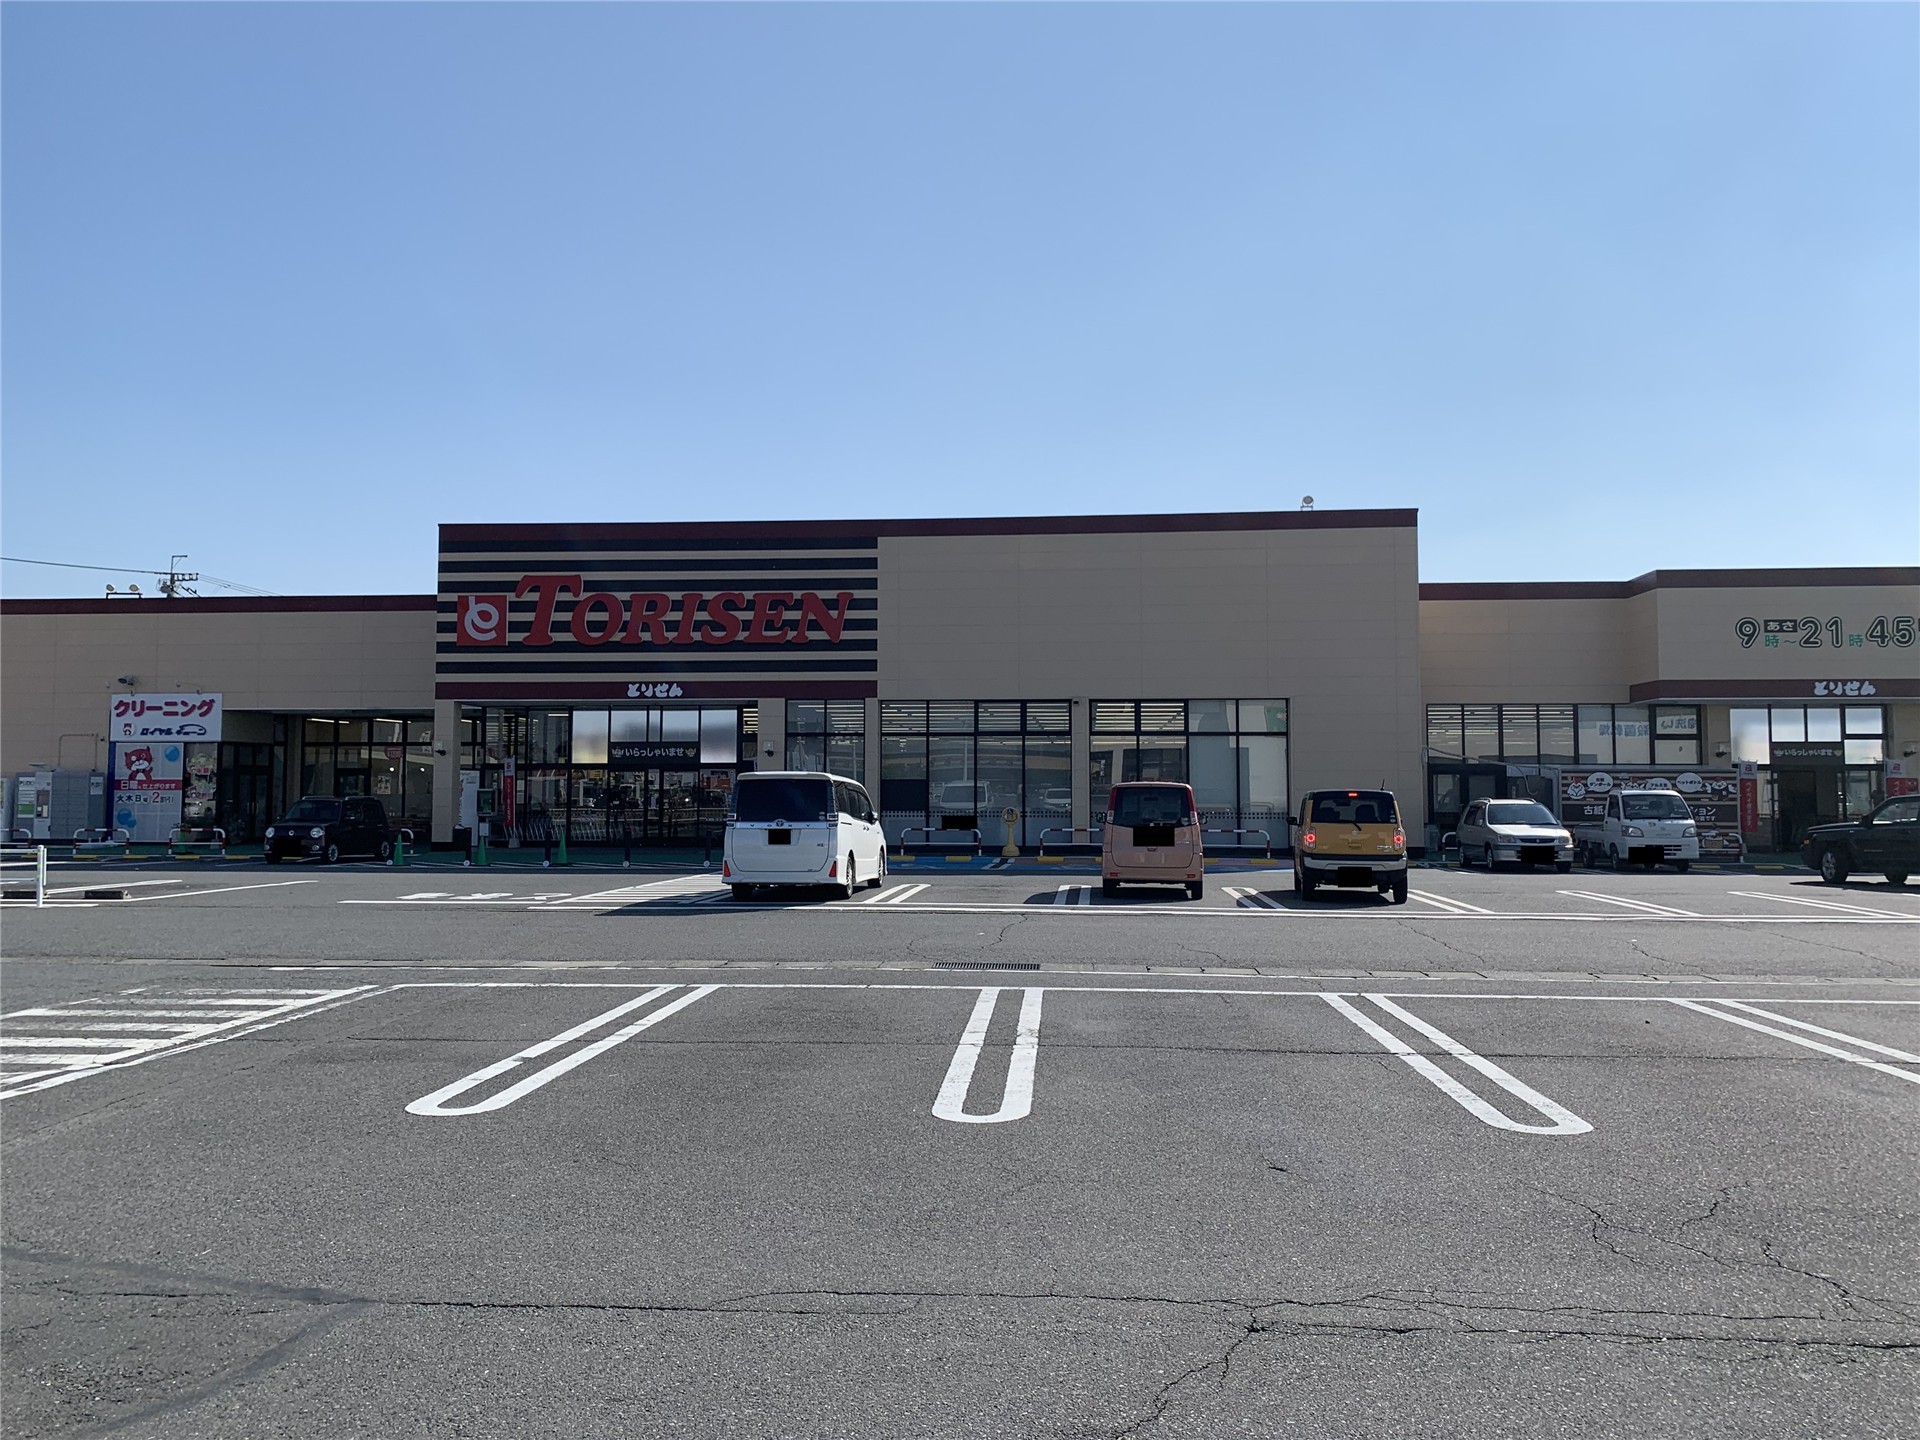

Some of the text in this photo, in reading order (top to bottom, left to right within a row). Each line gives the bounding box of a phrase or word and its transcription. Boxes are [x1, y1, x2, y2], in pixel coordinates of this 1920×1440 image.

[515, 573, 854, 647] TORISEN
[627, 682, 684, 698] とりせん
[1813, 680, 1877, 697] とりせん
[113, 698, 216, 718] クリーニング
[625, 747, 685, 758] いらっしゃいませ
[1784, 748, 1834, 757] いらっしゃいませ
